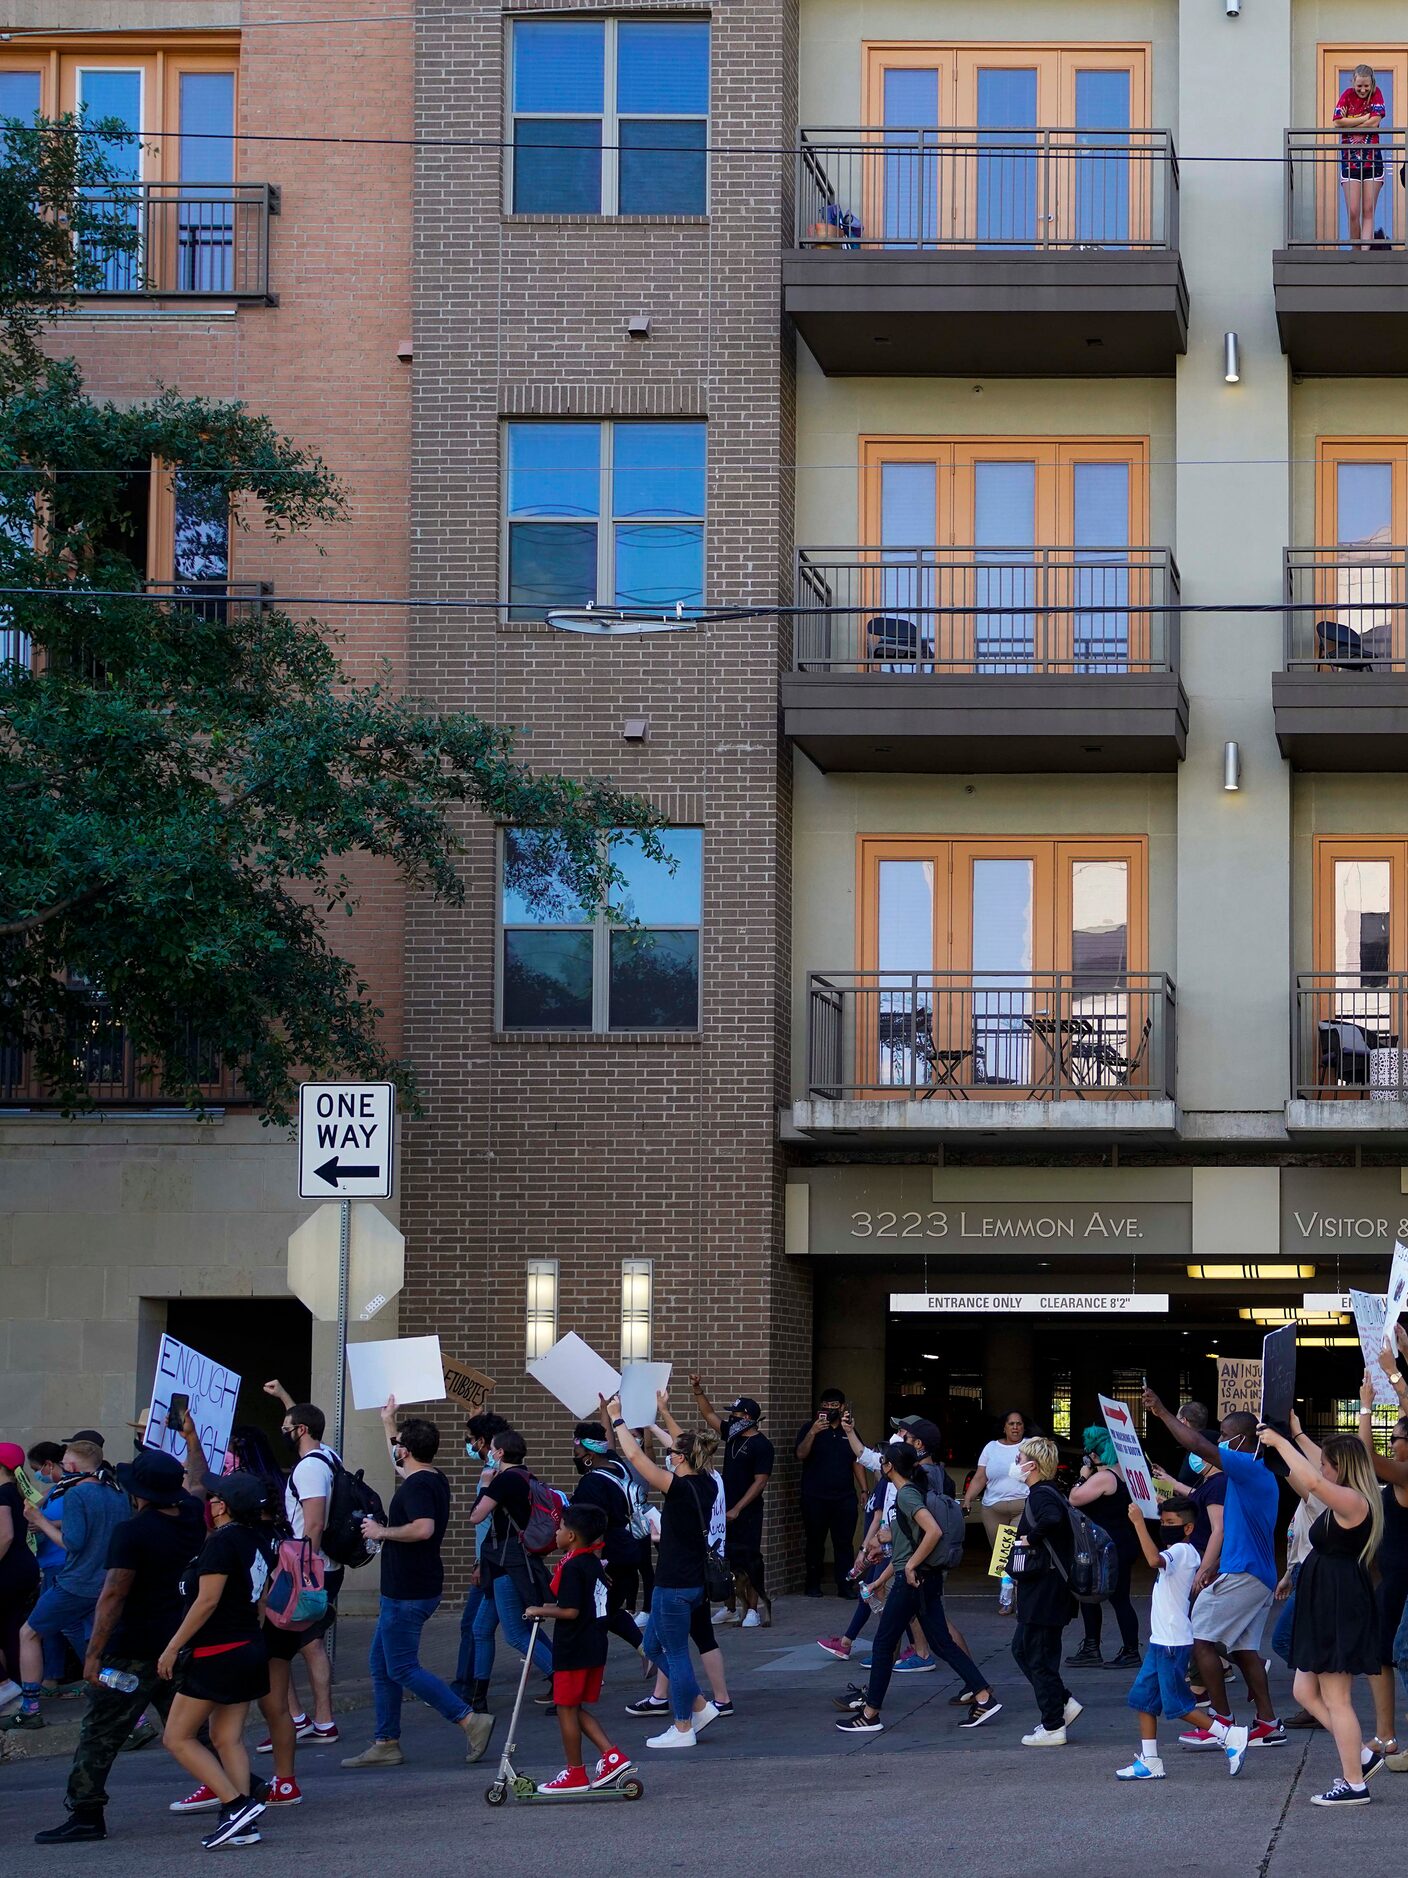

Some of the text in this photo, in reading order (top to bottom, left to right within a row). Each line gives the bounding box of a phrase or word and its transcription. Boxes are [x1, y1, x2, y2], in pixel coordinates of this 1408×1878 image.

[316, 1093, 375, 1118] ONE
[317, 1124, 379, 1149] WAY
[850, 1211, 949, 1238] 3223
[928, 1297, 991, 1309] ENTRANCE
[993, 1297, 1023, 1309] ONLY
[1040, 1297, 1108, 1309] CLEARANCE
[161, 1336, 241, 1413] ENOUGH
[1220, 1363, 1239, 1379] AN
[444, 1369, 489, 1407] ETUBBIES
[1220, 1379, 1262, 1389] TO ON
[1222, 1387, 1232, 1399] IS
[1232, 1388, 1248, 1400] AN
[1220, 1401, 1237, 1413] TO
[998, 1536, 1013, 1564] BLACK
